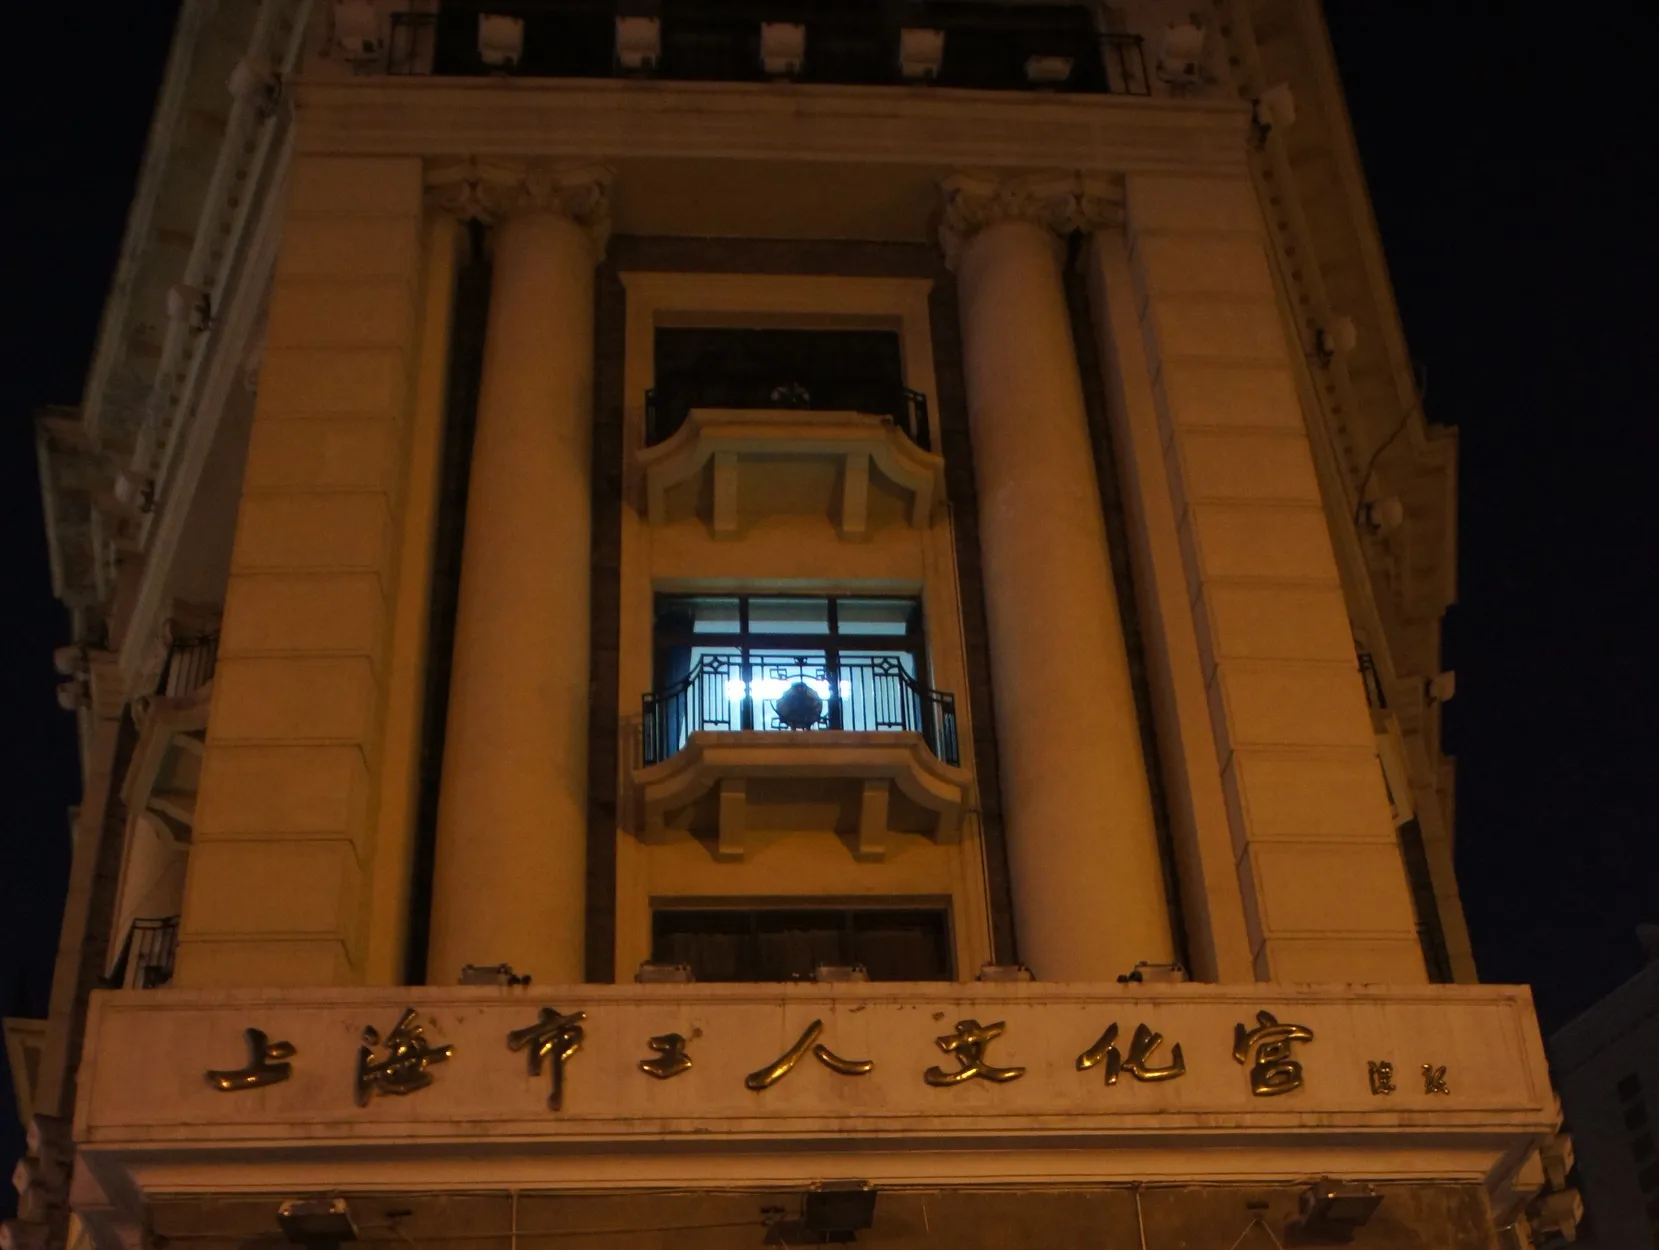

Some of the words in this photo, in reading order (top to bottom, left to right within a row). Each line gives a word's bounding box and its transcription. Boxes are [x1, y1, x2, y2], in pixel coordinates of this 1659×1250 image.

[206, 1006, 1315, 1111] 上海市工人文化宫
